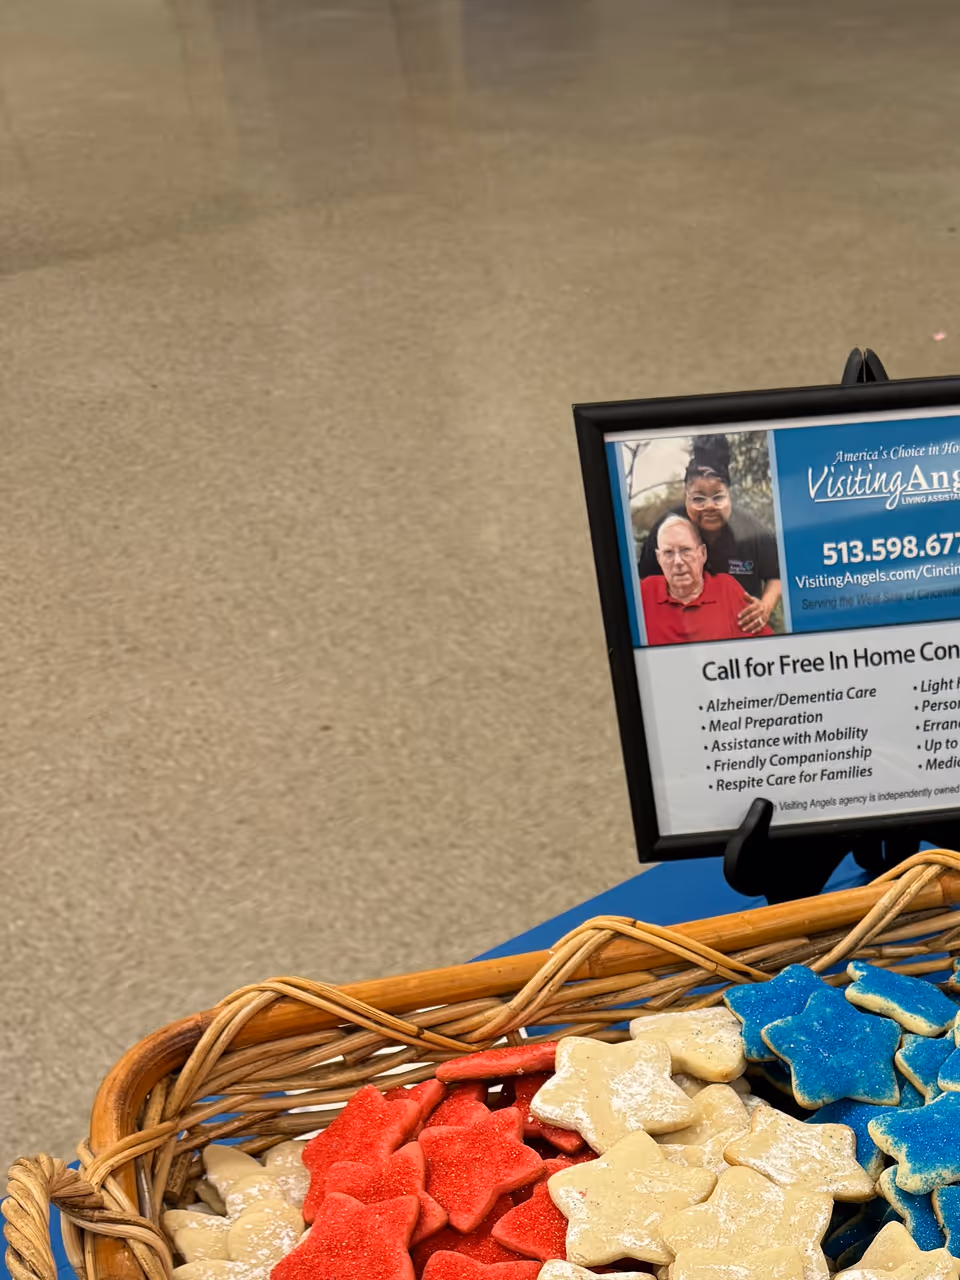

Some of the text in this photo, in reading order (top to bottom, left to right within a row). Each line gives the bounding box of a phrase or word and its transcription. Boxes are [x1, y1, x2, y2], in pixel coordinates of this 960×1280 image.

[833, 447, 888, 465] America's
[889, 443, 926, 459] Choice
[928, 440, 940, 455] in
[901, 493, 926, 505] LIVING
[801, 597, 837, 610] Serving
[702, 659, 742, 682] Call
[744, 656, 776, 678] for
[779, 650, 824, 675] Free
[829, 650, 850, 670] In
[853, 644, 915, 669] Home
[919, 677, 955, 695] Light
[705, 685, 878, 714] Alzheimer/Dementia Care
[708, 710, 824, 733] Meal Preparation
[711, 725, 869, 753] Assistance with Mobility
[924, 738, 943, 754] Up
[945, 738, 958, 751] to
[713, 744, 873, 774] Friendly Companionship
[716, 763, 874, 794] Respite Care for Families
[779, 799, 808, 813] Visiting
[809, 796, 837, 810] Angels
[838, 794, 868, 809] agency
[868, 793, 877, 804] is
[877, 785, 933, 803] independently
[933, 784, 960, 797] owned
